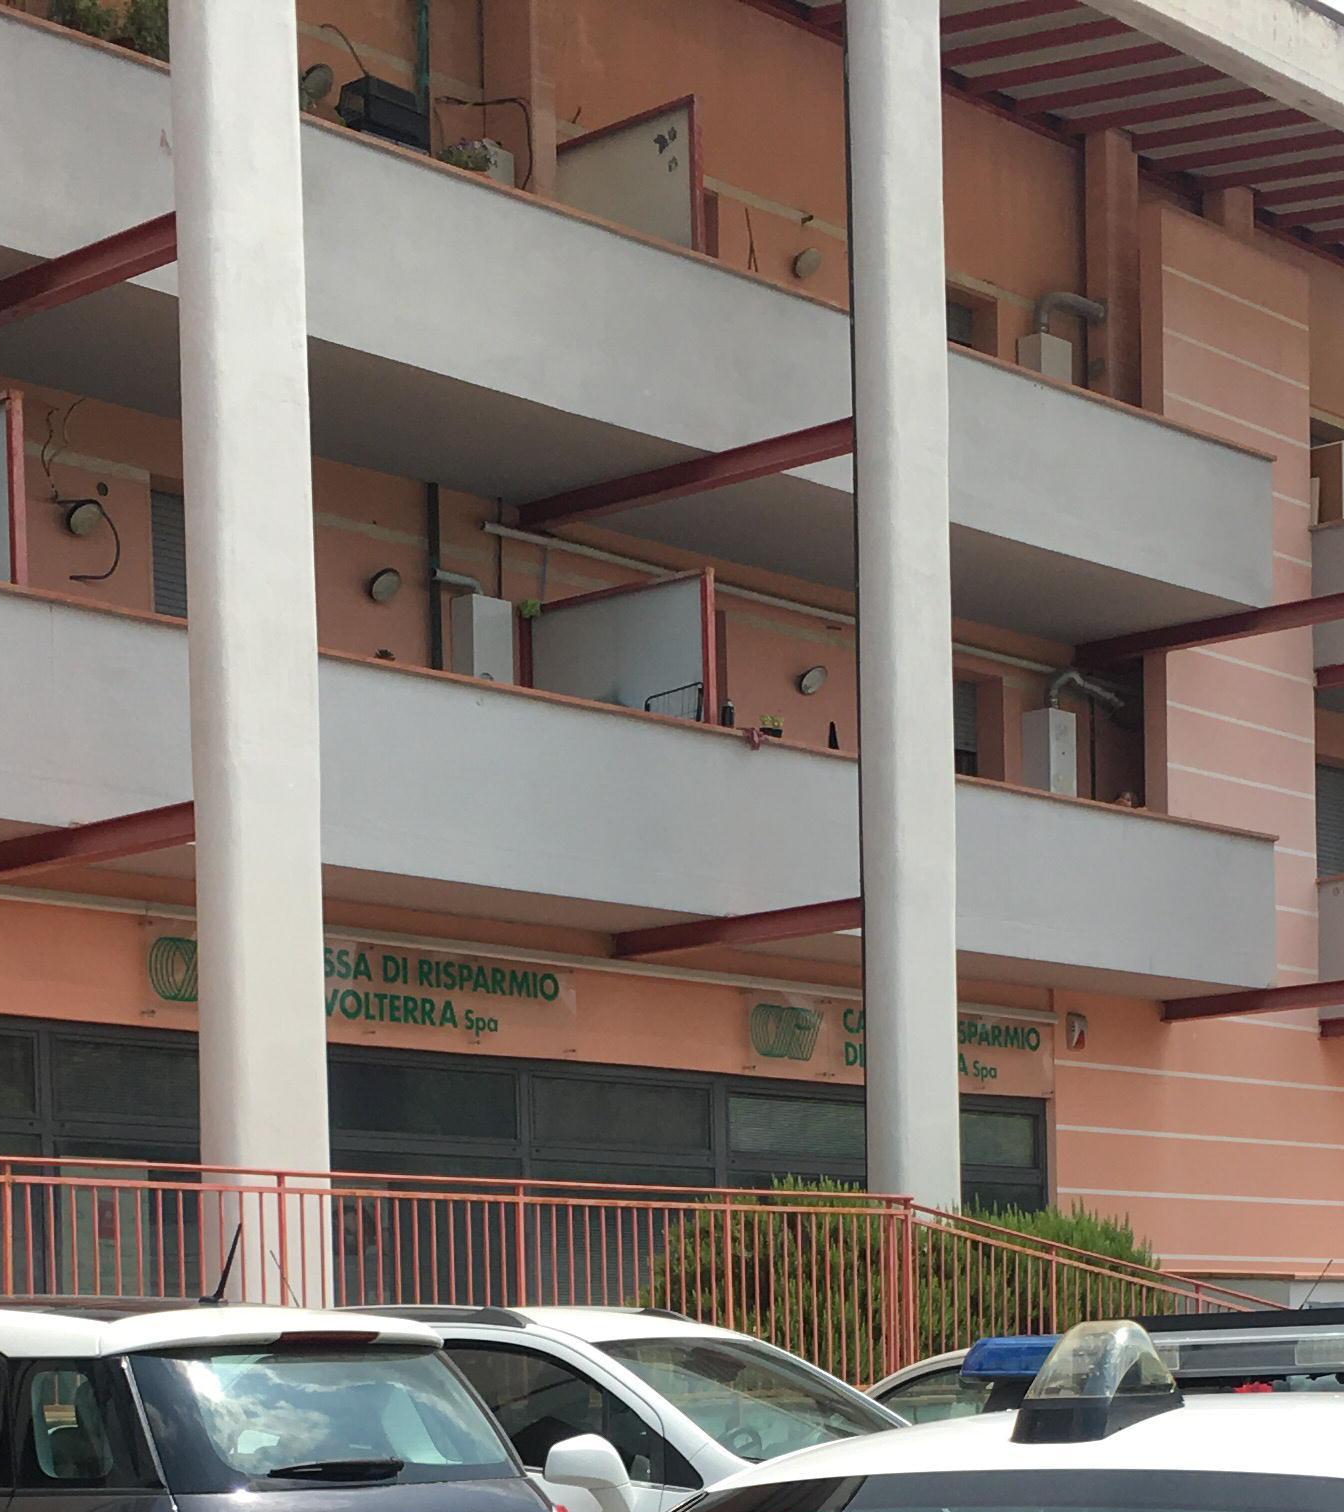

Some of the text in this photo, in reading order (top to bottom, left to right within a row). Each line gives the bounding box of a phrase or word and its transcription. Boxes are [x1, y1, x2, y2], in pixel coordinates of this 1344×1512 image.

[324, 947, 560, 1002] SSA DI RISPARMIO
[464, 1009, 498, 1037] Spa
[959, 1020, 1041, 1052] SPARMIO
[972, 1060, 997, 1082] Spa
